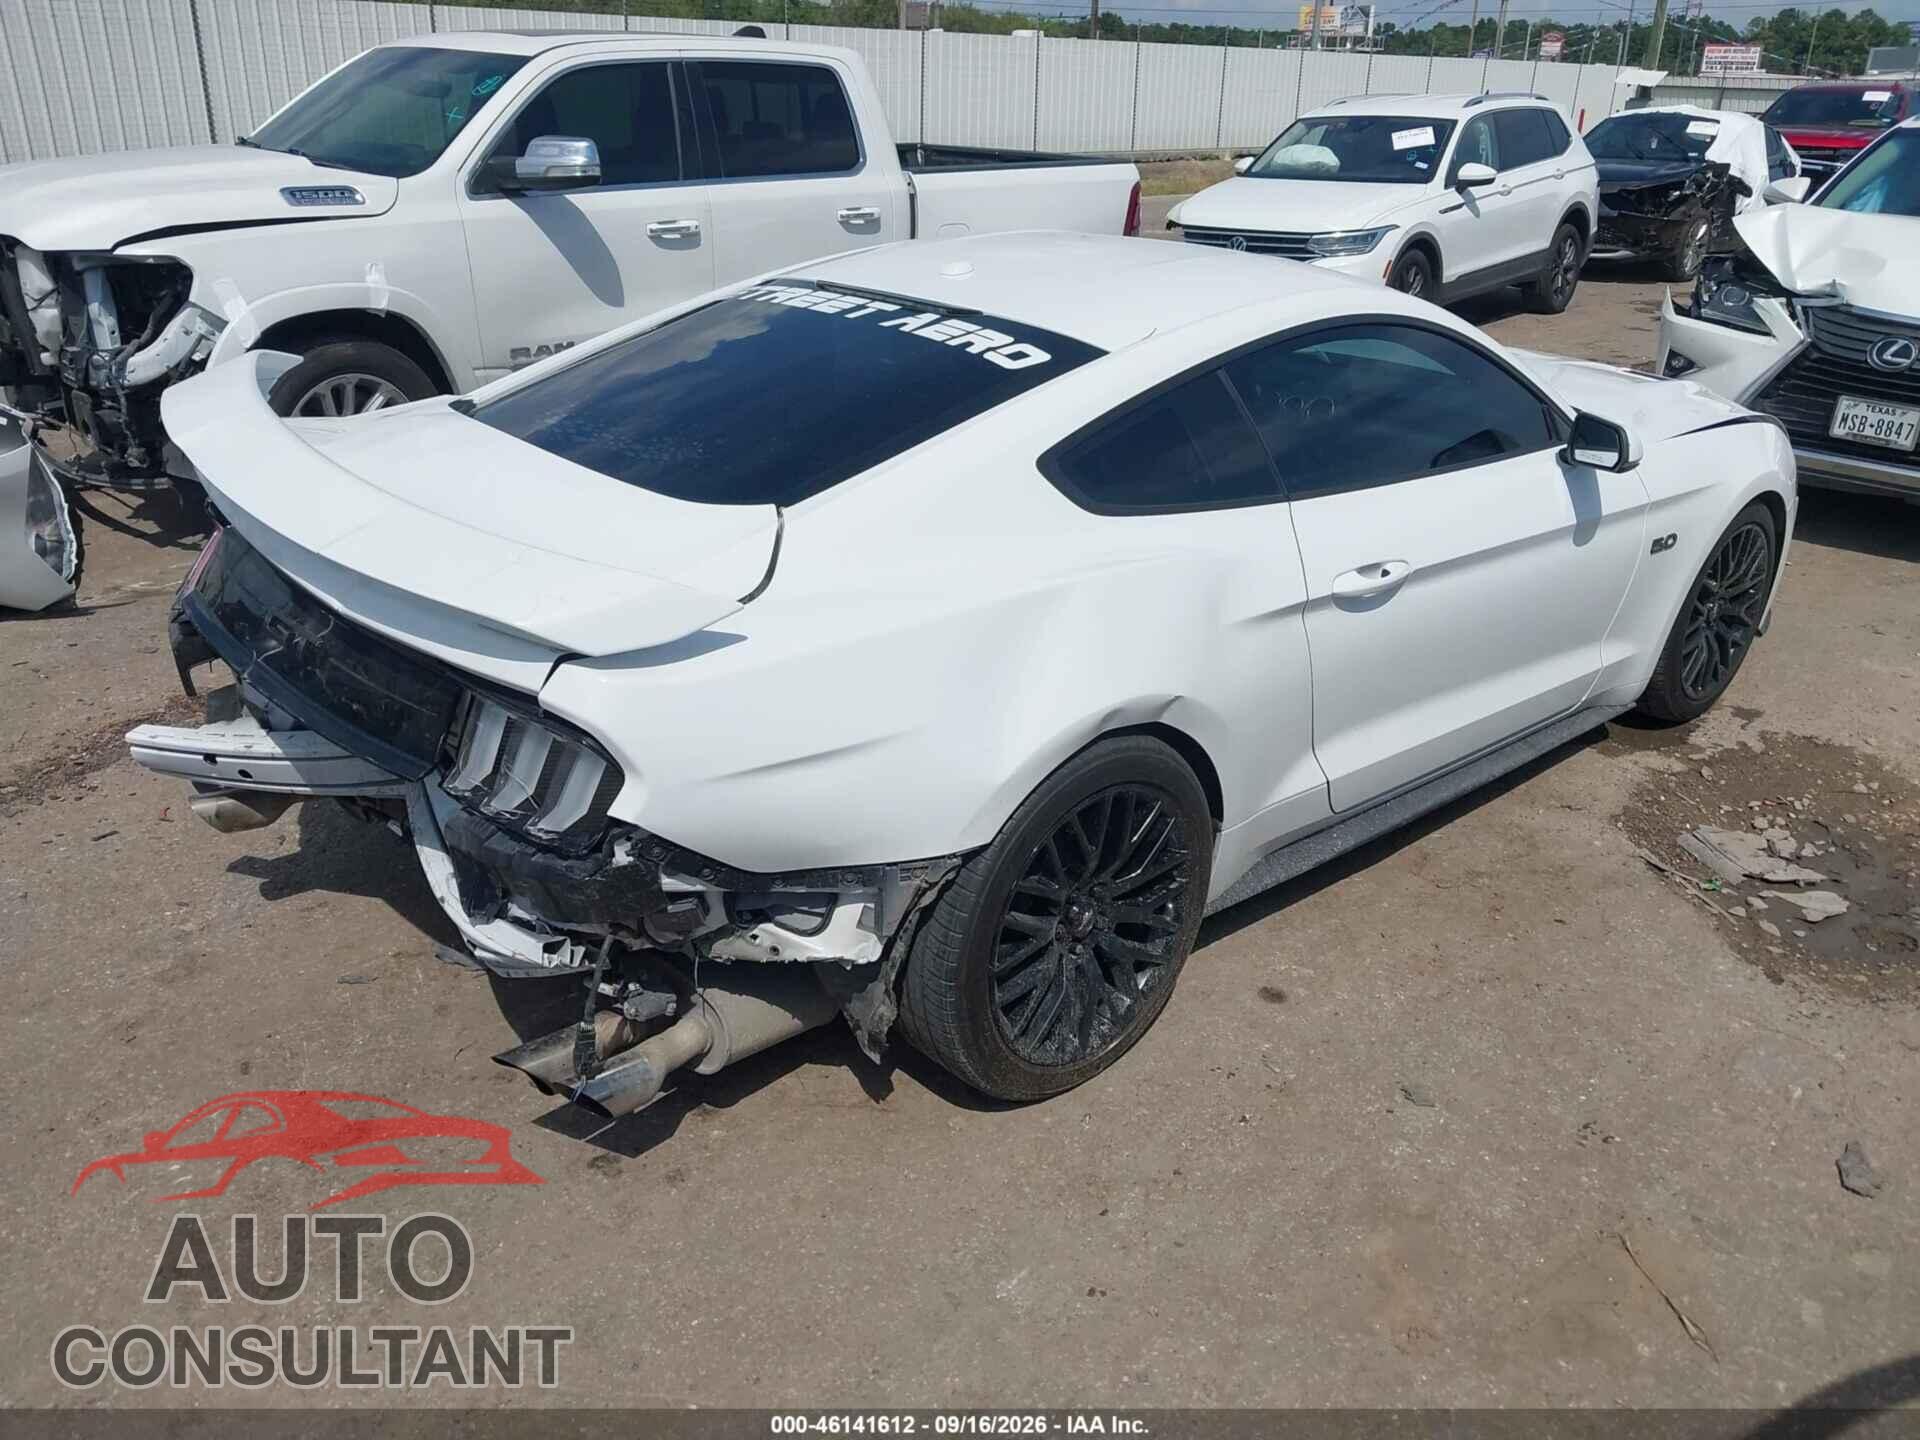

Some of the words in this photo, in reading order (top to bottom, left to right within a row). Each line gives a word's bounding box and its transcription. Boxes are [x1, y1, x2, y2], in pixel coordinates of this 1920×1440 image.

[292, 190, 352, 199] 1500
[737, 286, 902, 318] TREET
[877, 312, 1052, 370] AERO
[1866, 404, 1897, 416] TEXAS
